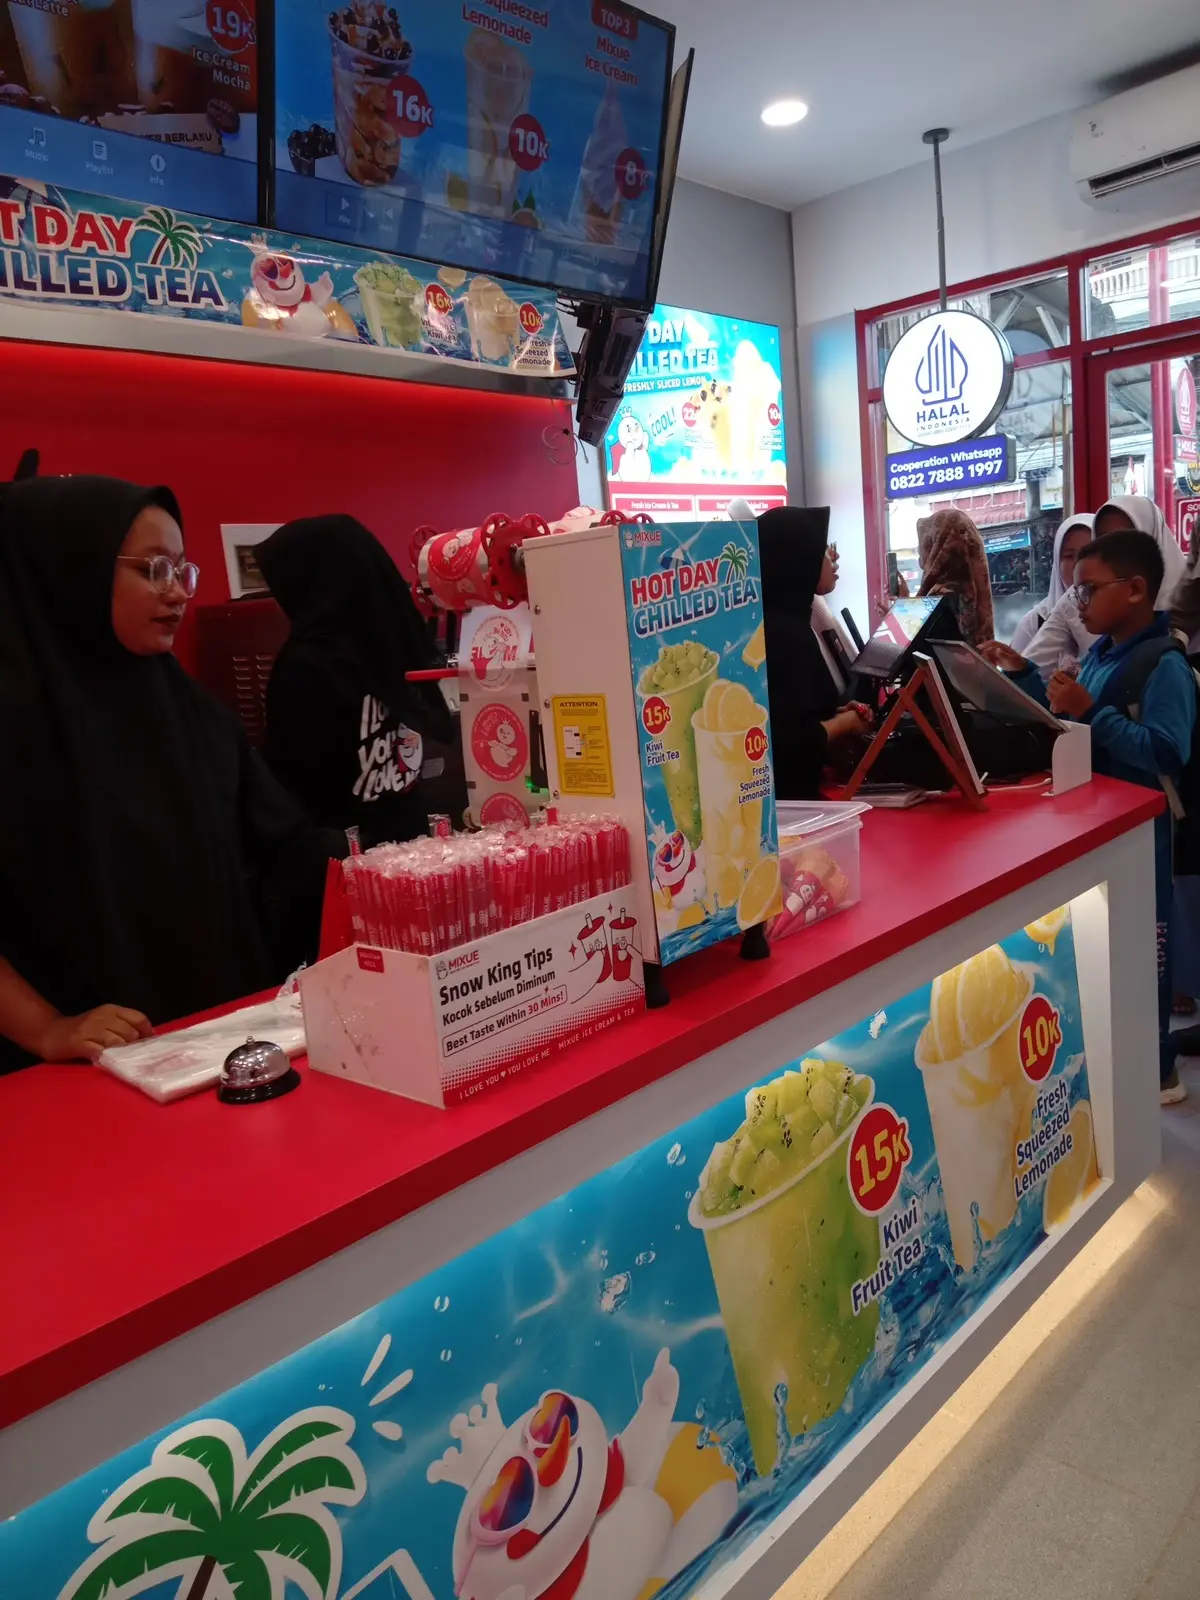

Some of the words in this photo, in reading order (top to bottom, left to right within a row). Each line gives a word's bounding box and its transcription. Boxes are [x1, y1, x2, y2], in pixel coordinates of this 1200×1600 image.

[212, 7, 254, 38] 19K
[462, 5, 532, 44] Lemonade
[601, 9, 622, 29] TOP
[623, 20, 631, 34] 3
[192, 47, 213, 62] Ice
[212, 53, 249, 74] Cream
[597, 36, 630, 62] Mixue
[213, 70, 250, 90] Mocha
[585, 54, 600, 72] Ice
[602, 62, 637, 86] Cream
[393, 90, 434, 125] 16K
[164, 132, 212, 143] BERLAKU
[515, 128, 549, 159] 10K
[25, 149, 49, 162] Music
[85, 162, 114, 176] Playlist
[34, 205, 134, 255] DAY
[0, 250, 130, 302] ILLED
[138, 266, 225, 308] TEA
[522, 311, 542, 328] 10K
[649, 320, 685, 345] DAY
[684, 347, 719, 372] TEA
[623, 381, 655, 393] FRESHLY
[657, 378, 681, 389] SLICED
[917, 403, 970, 423] HALAL
[917, 416, 970, 432] INDONESIA
[890, 456, 949, 473] Cooperation
[950, 447, 1002, 462] Whatsapp
[890, 473, 925, 490] 0822
[928, 467, 964, 485] 7888
[968, 460, 1003, 478] 1997
[635, 531, 660, 541] MIXUE
[631, 571, 676, 607] HOT
[679, 558, 721, 593] DAY
[634, 589, 718, 636] CHILLED
[720, 581, 758, 610] TEA
[645, 705, 671, 727] 15K
[646, 740, 663, 754] Kiwi
[647, 753, 666, 766] Fruit
[666, 750, 680, 761] Tea
[747, 735, 768, 754] 10K
[752, 764, 770, 776] Fresh
[738, 787, 771, 804] Lemonade
[739, 775, 770, 793] Squeezed
[449, 950, 479, 970] MIXUE
[439, 977, 484, 1005] Snow
[487, 959, 522, 988] King
[524, 947, 553, 970] Tips
[442, 1005, 473, 1026] Kocok
[475, 989, 515, 1013] Sebelum
[516, 971, 556, 994] Diminum
[446, 1035, 468, 1052] Best
[469, 1024, 495, 1043] Taste
[497, 1010, 527, 1031] Within
[528, 1004, 539, 1015] 30
[540, 991, 564, 1011] Mins!
[558, 1034, 580, 1050] MIXUE
[582, 1029, 593, 1039] ICE
[594, 1016, 615, 1033] CREAM
[617, 1013, 622, 1021] &
[623, 1007, 635, 1018] TEA
[1022, 1015, 1060, 1069] 10K
[464, 1083, 484, 1098] LOVE
[485, 1075, 500, 1090] YOU
[507, 1066, 521, 1079] YOU
[523, 1056, 540, 1071] LOVE
[540, 1048, 551, 1058] ME
[1035, 1079, 1068, 1119] Fresh
[1016, 1106, 1070, 1166] Squeezed
[854, 1121, 908, 1197] 15K
[1014, 1133, 1073, 1200] Lemonade
[883, 1199, 919, 1249] Kiwi
[851, 1266, 894, 1313] Fruit
[894, 1237, 922, 1276] Tea
